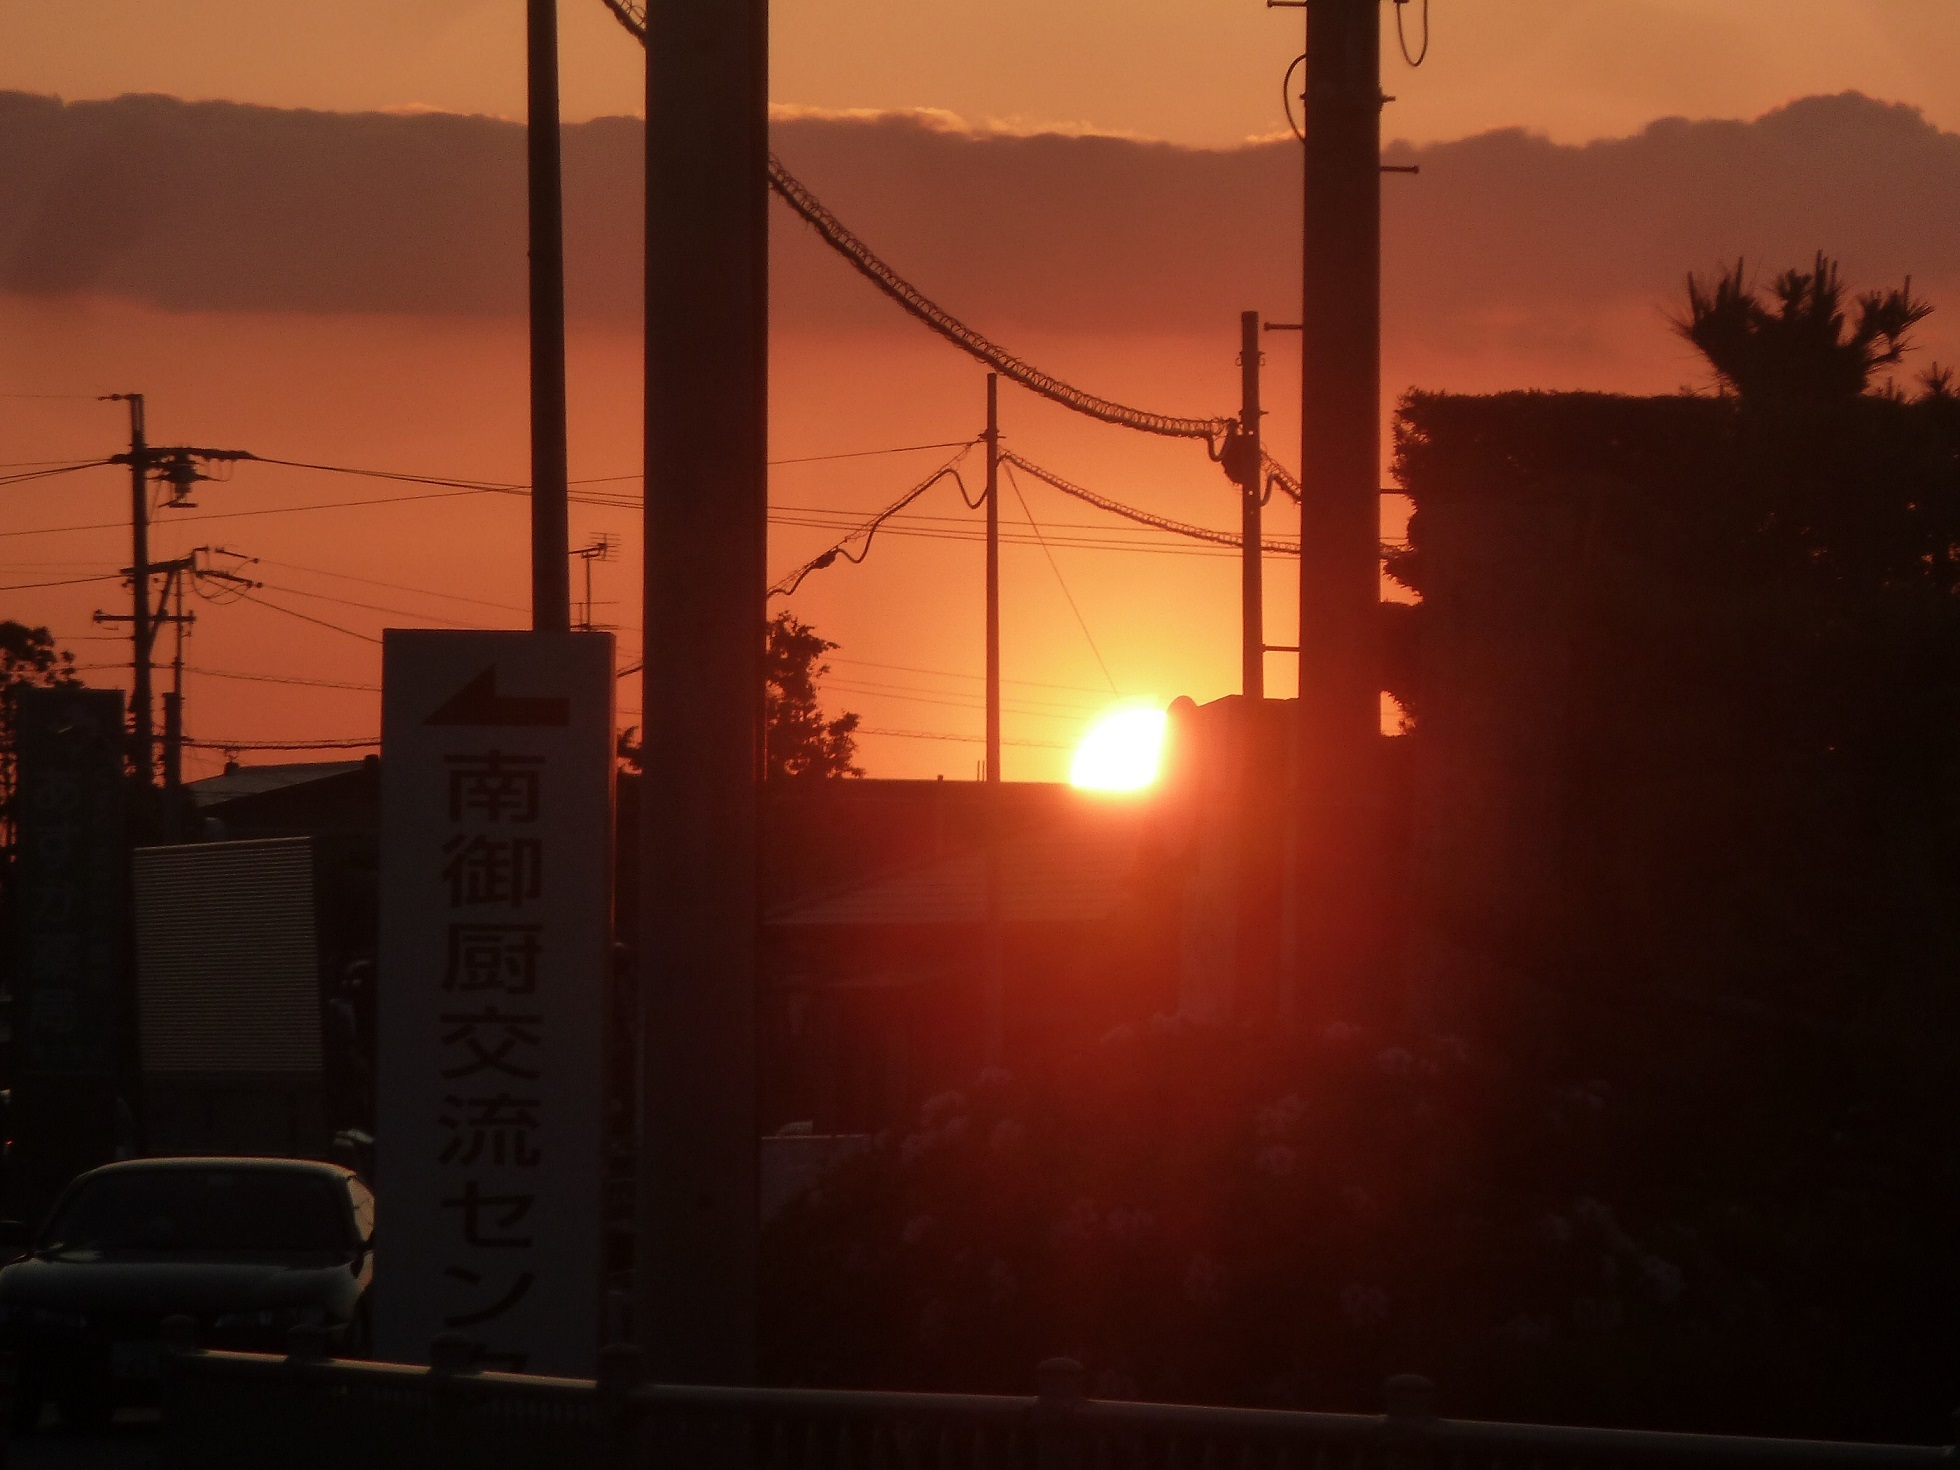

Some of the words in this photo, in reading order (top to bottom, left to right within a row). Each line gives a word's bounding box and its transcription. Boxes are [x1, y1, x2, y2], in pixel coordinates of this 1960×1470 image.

[28, 768, 82, 1035] あすか薬局
